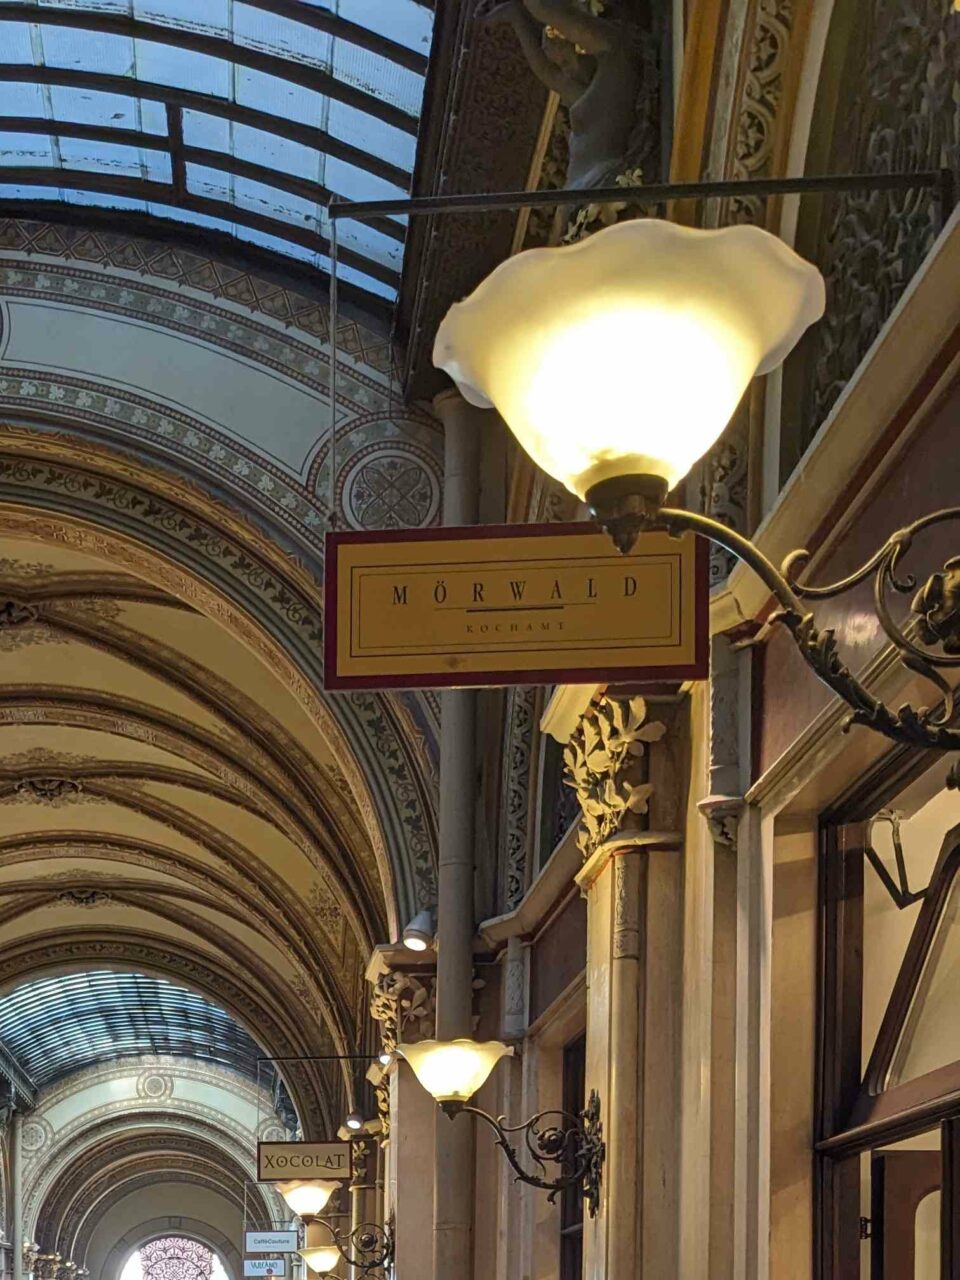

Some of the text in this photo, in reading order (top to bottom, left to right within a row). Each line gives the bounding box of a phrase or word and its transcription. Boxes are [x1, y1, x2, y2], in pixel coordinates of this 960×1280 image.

[392, 576, 638, 606] MÖRWALD
[466, 621, 565, 634] KOCHAMT
[264, 1153, 346, 1170] XOCOLAT
